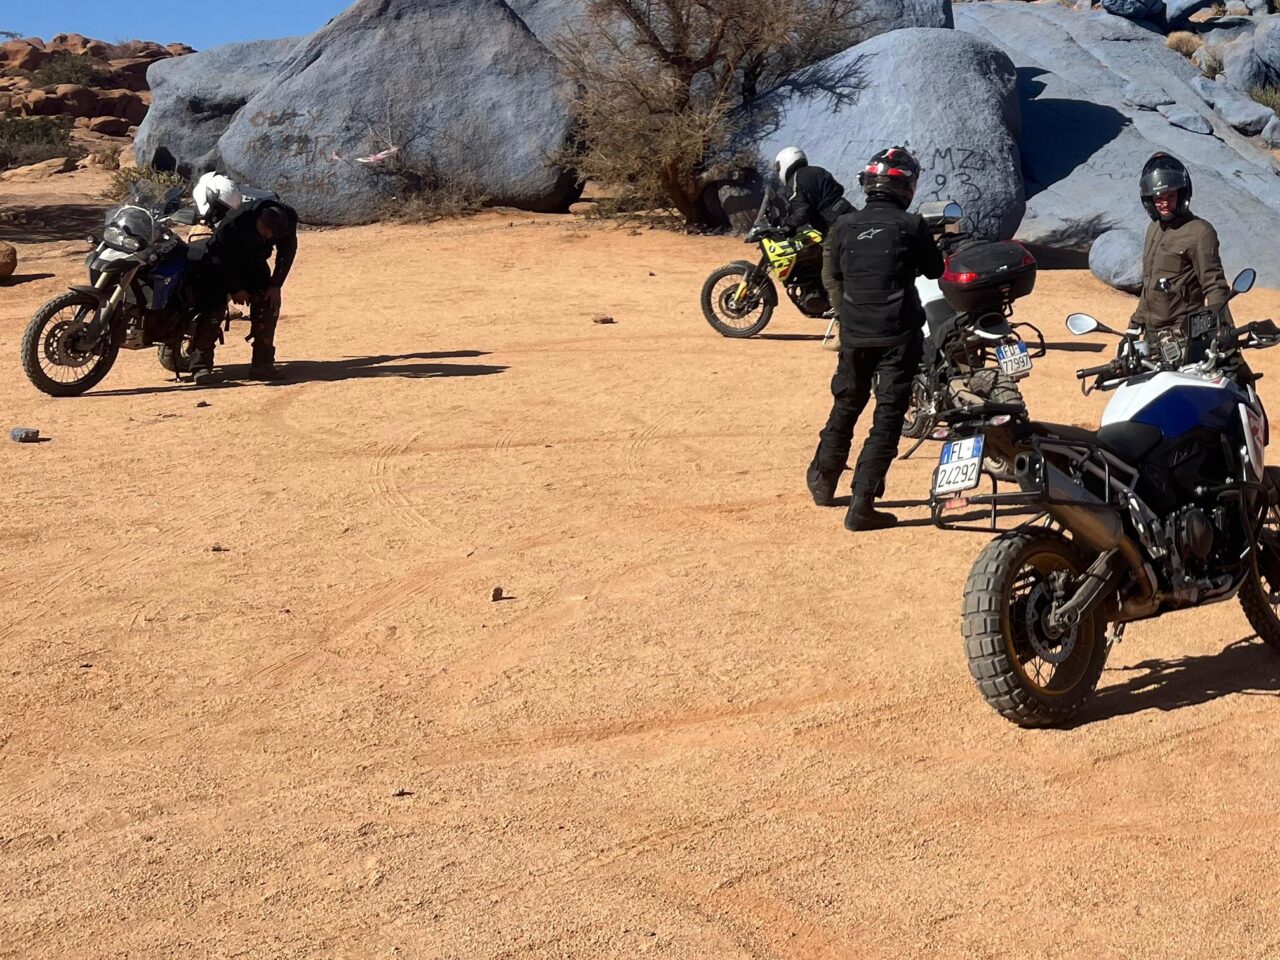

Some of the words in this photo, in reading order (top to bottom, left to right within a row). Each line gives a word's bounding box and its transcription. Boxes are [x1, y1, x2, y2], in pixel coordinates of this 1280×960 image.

[1002, 354, 1029, 373] 77997
[950, 441, 965, 461] FL
[937, 462, 977, 488] 24292
